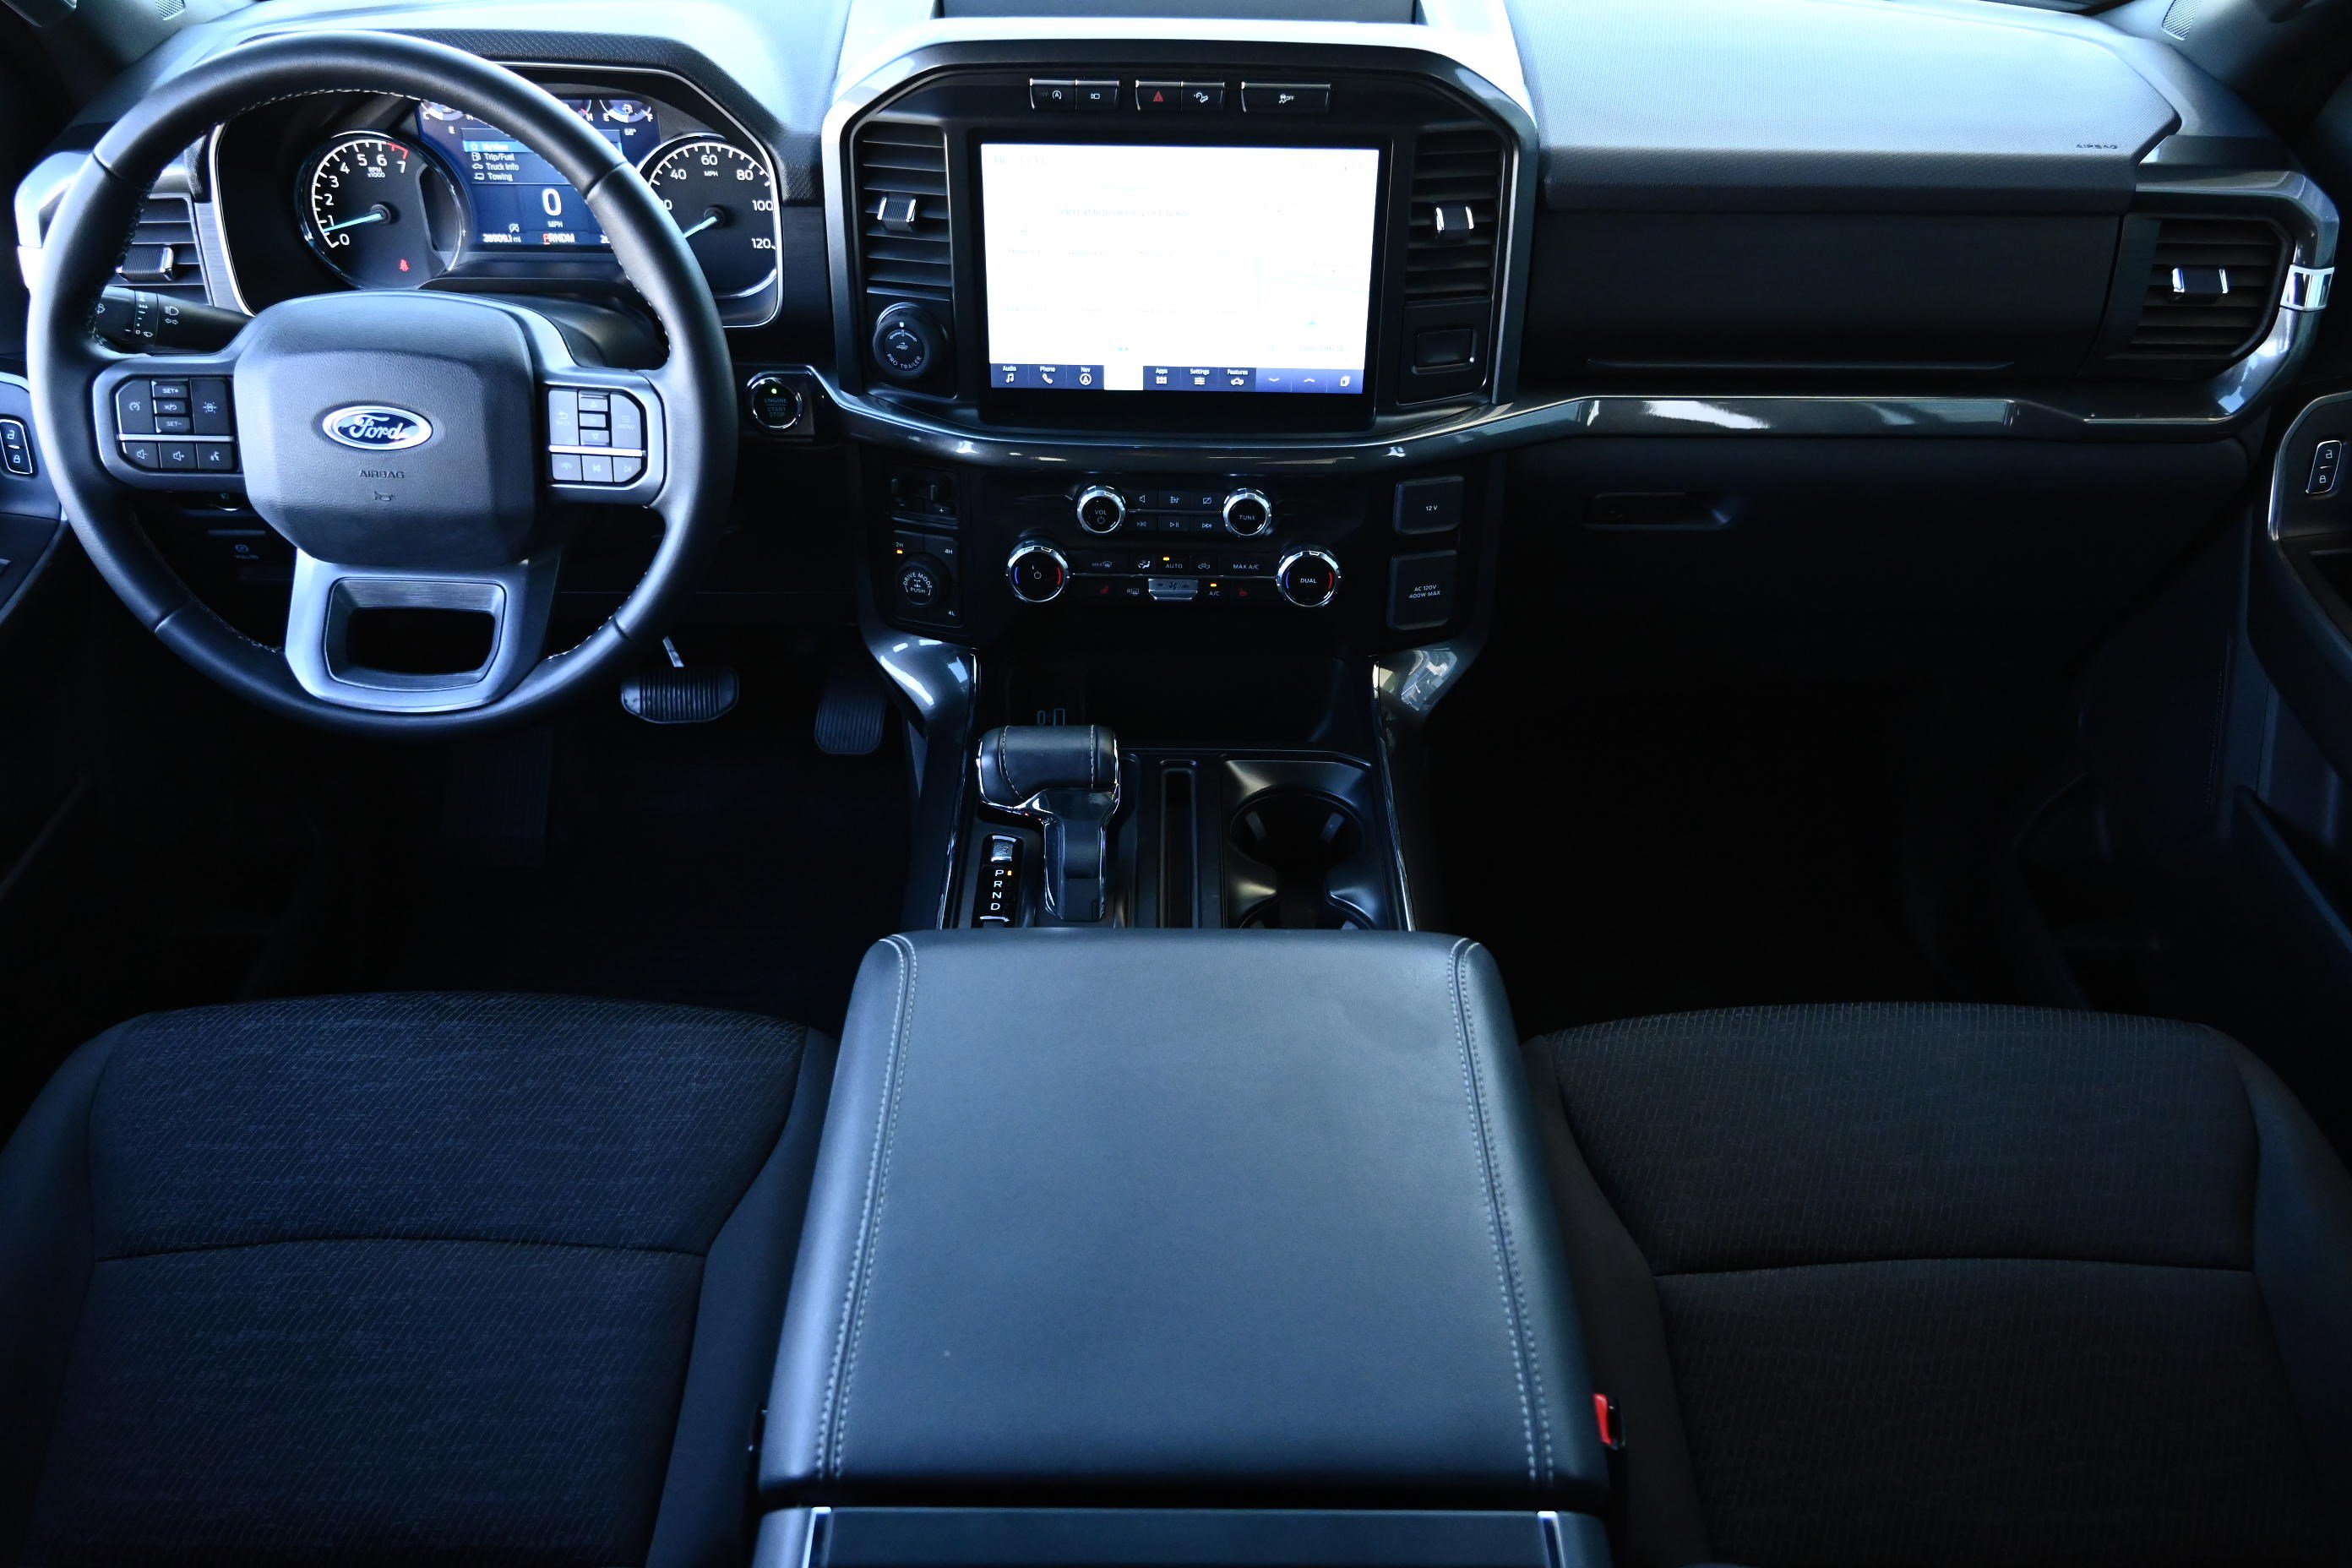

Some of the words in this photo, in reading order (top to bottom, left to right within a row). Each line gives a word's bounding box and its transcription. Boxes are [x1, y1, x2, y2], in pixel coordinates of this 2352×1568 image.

[586, 112, 594, 122] H
[603, 112, 610, 122] E
[647, 113, 654, 122] F
[357, 154, 368, 166] 5
[376, 155, 388, 166] 6
[483, 153, 515, 161] Trip/Fuel
[700, 155, 718, 166] 60
[340, 162, 351, 174] 4
[396, 161, 406, 173] 7
[485, 162, 505, 171] Truck
[487, 172, 514, 182] Towing
[670, 169, 687, 180] 40
[736, 169, 754, 181] 80
[329, 176, 340, 188] 3
[324, 193, 335, 205] 2
[542, 188, 563, 217] 0
[752, 200, 774, 211] 100
[340, 233, 351, 246] 0
[752, 238, 770, 249] 120
[887, 353, 898, 366] PRO
[900, 356, 922, 369] TRAILER
[349, 414, 405, 440] Ford
[360, 470, 406, 479] AIRBAG
[903, 572, 917, 586] DRIVE
[917, 572, 933, 589] MODE
[990, 902, 1001, 911] D
